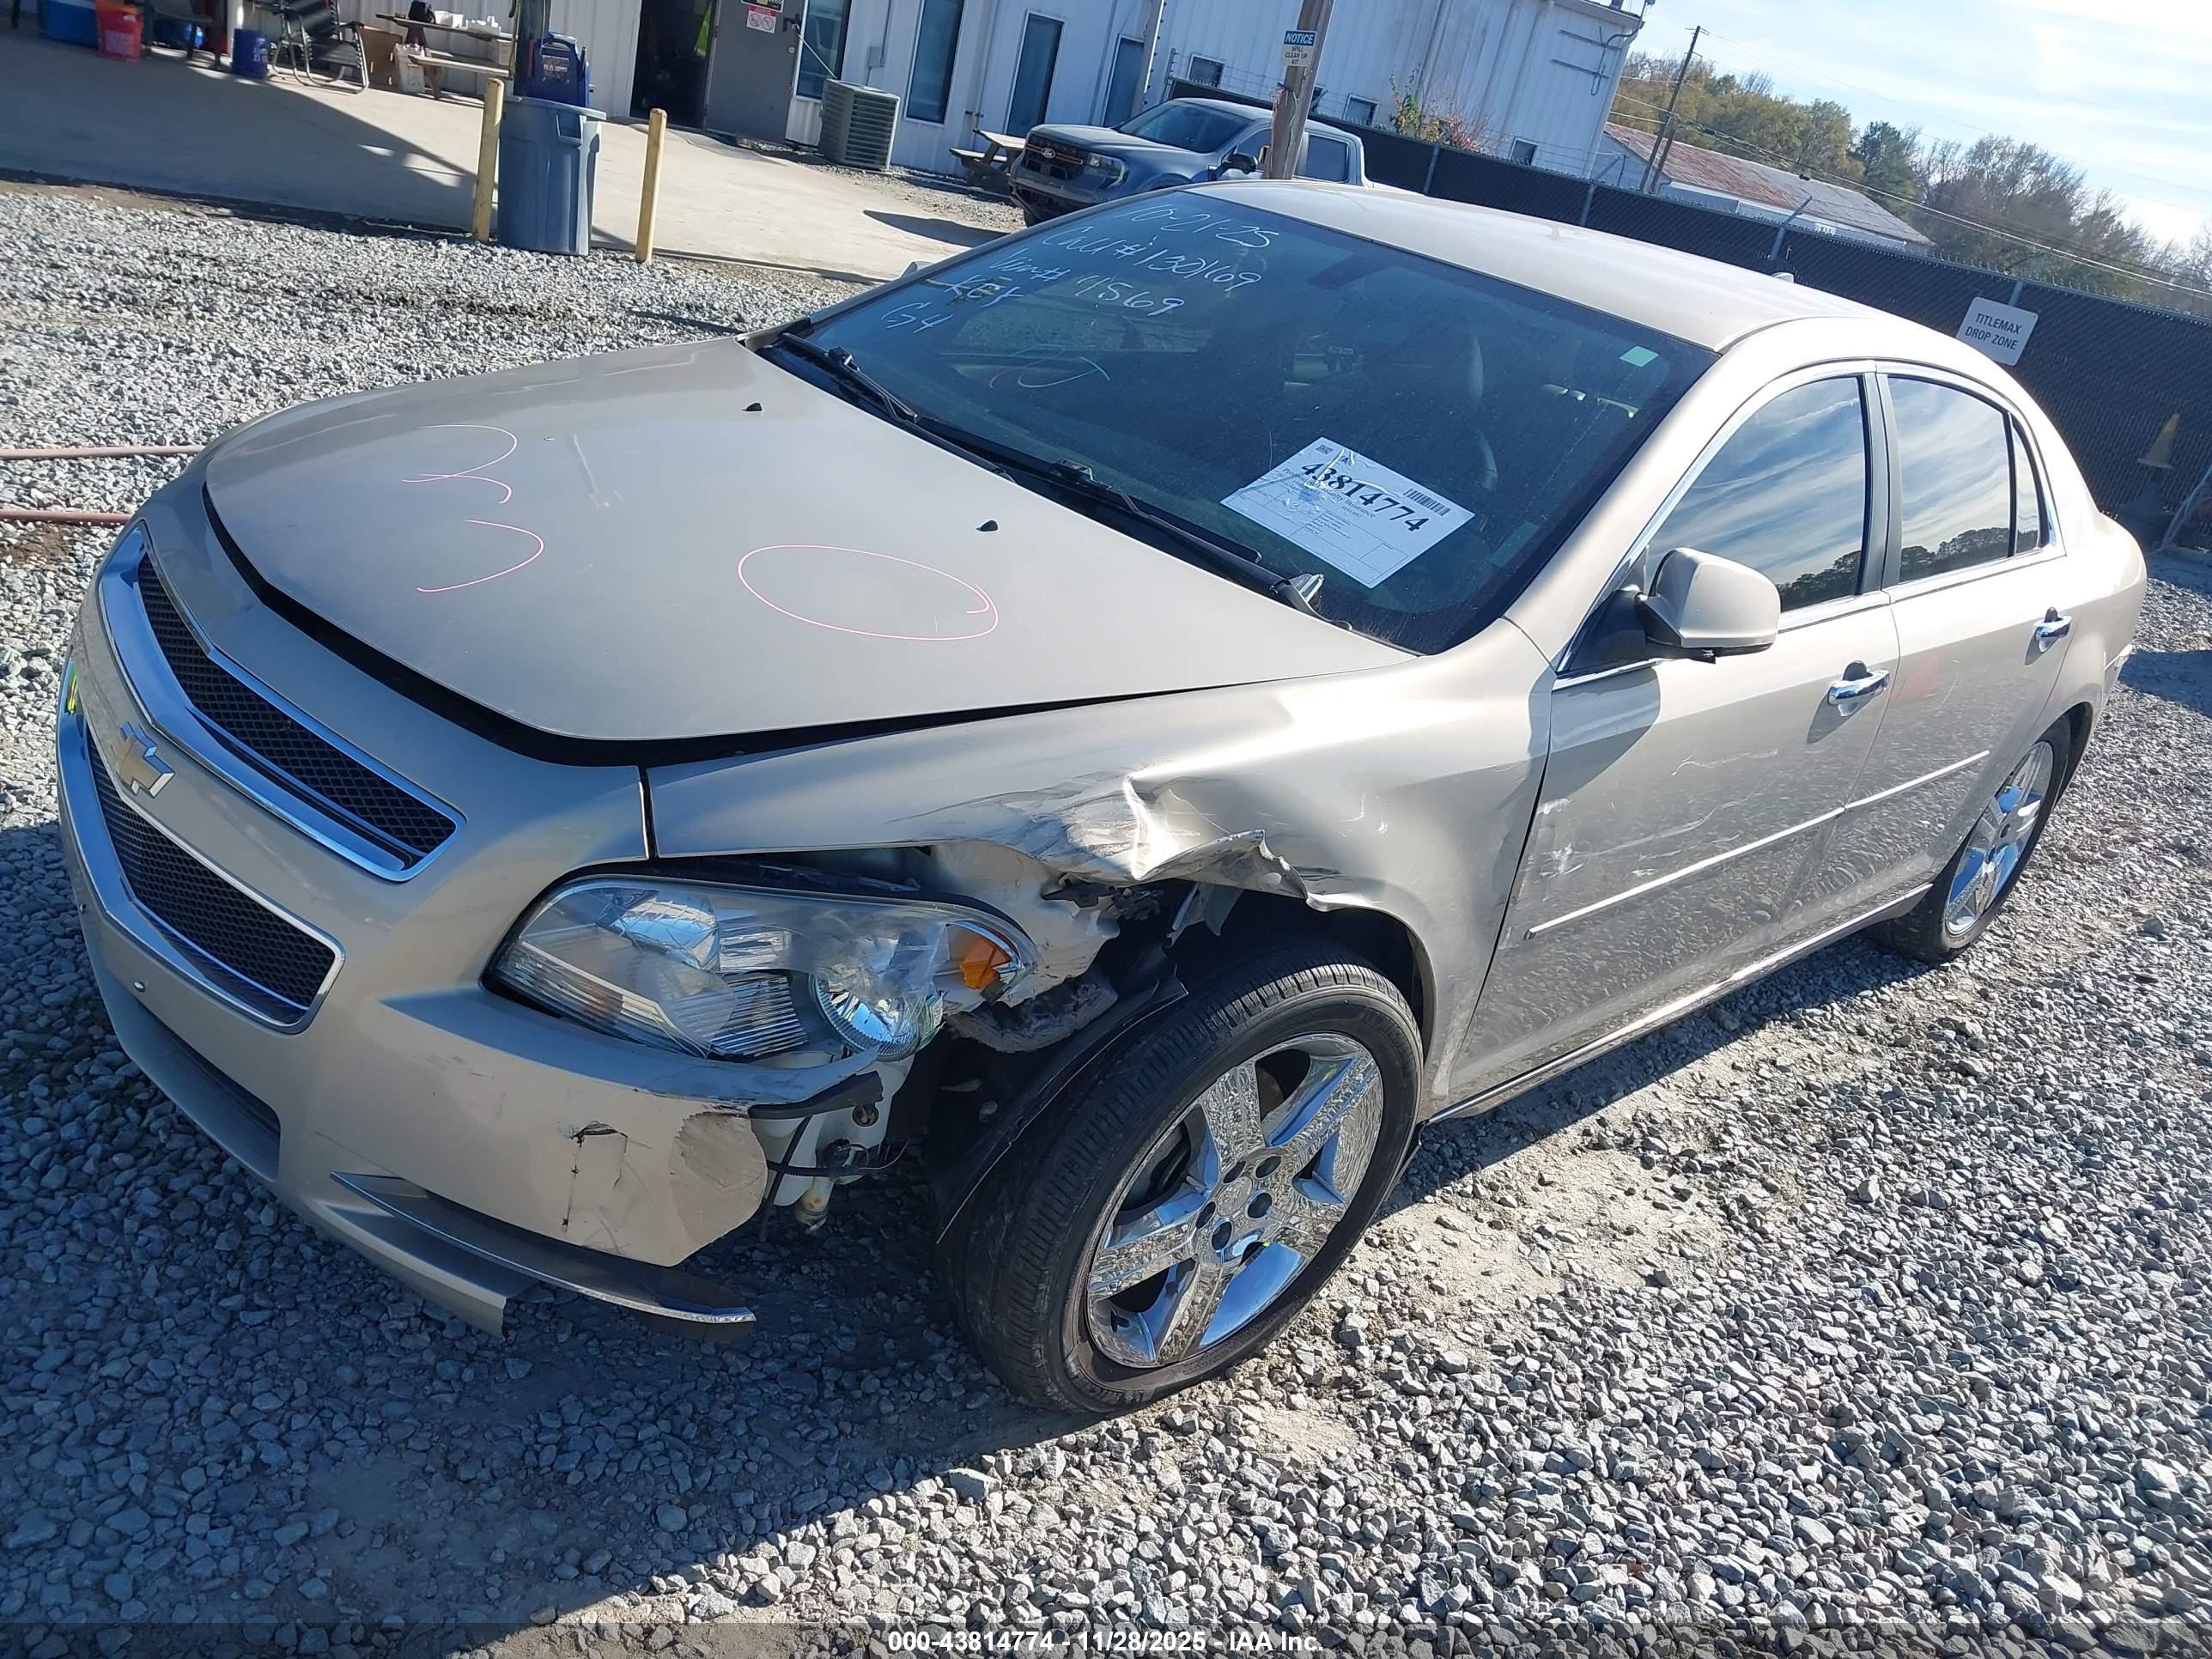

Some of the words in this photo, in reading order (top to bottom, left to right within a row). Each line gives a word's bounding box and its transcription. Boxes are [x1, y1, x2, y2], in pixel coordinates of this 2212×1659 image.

[1285, 33, 1315, 45] NOTICE
[1975, 313, 2022, 334] TITLEMAX
[1965, 325, 1991, 342] DROP
[1991, 333, 2019, 350] ZONE
[1300, 462, 1430, 532] 43814774
[1344, 499, 1376, 518] Insurance
